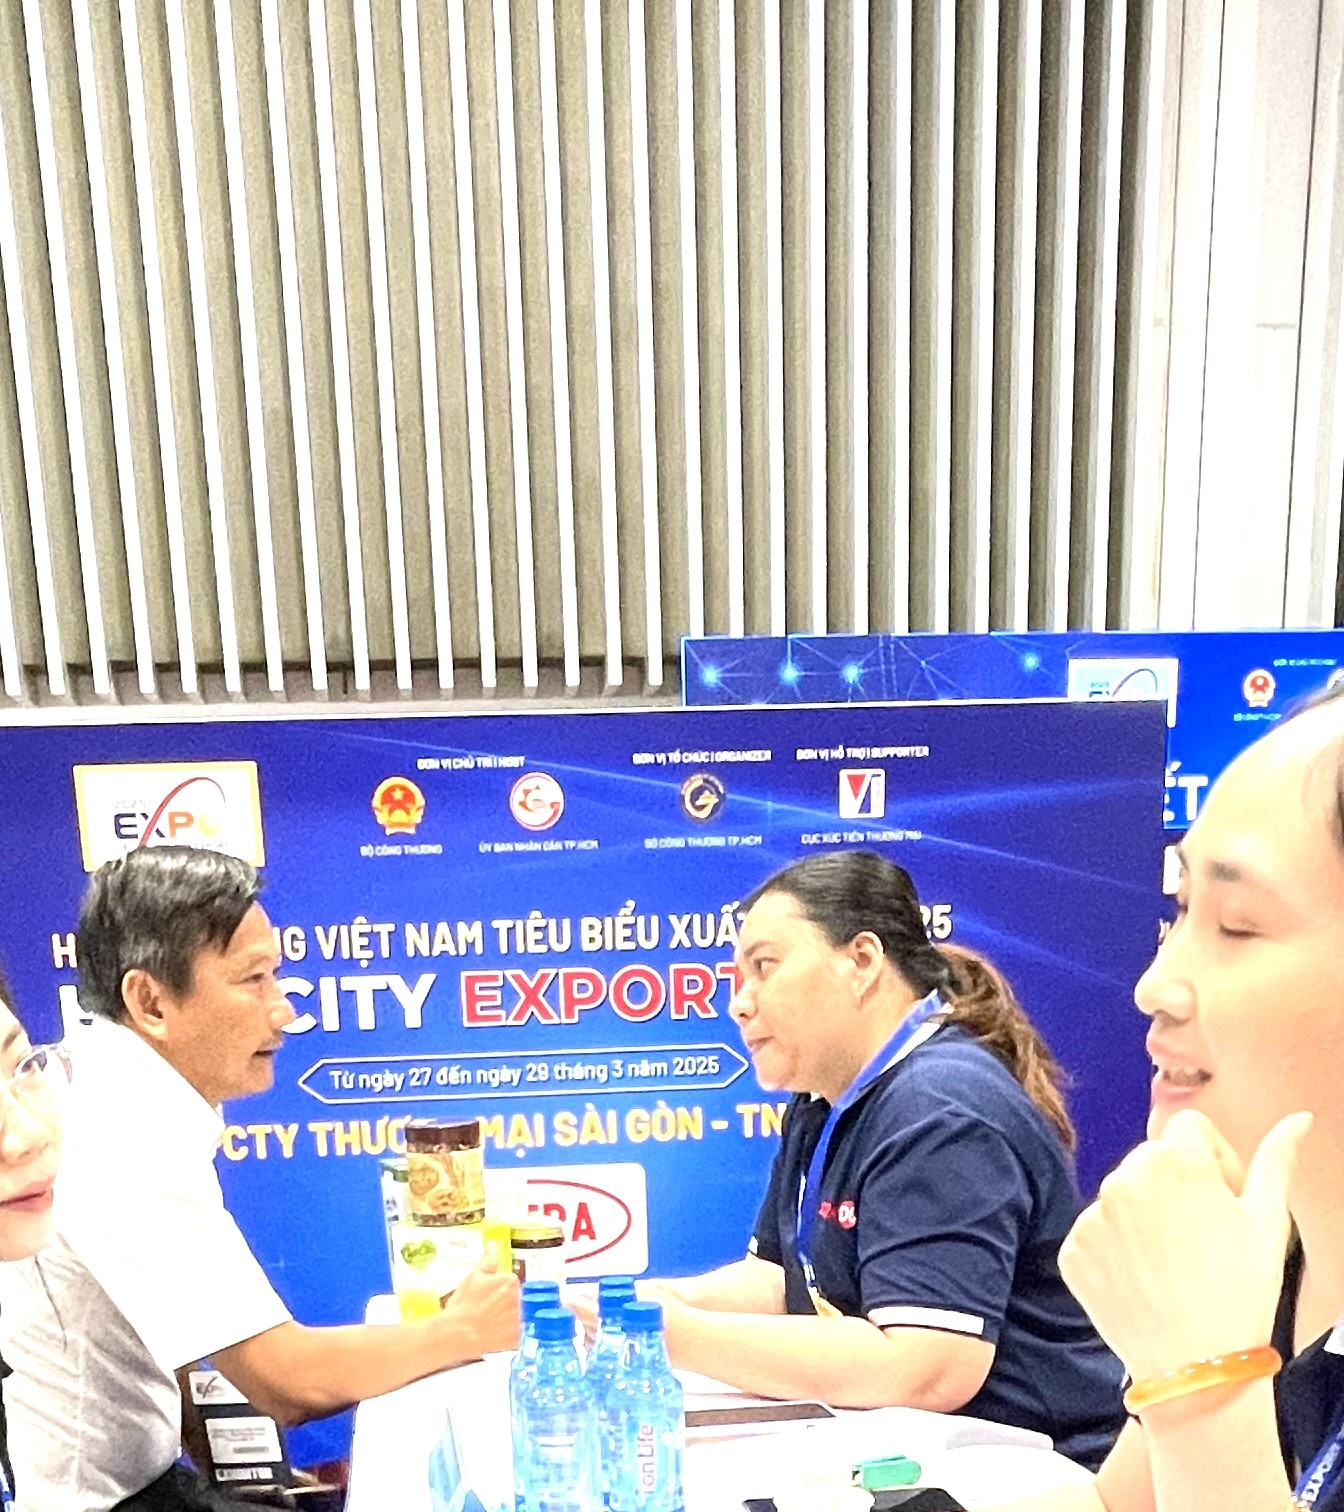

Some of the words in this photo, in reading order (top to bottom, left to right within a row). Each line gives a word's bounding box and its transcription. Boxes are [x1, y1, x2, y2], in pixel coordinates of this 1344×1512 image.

[715, 749, 772, 763] ORGANIZER
[871, 746, 930, 759] SUPPORTER
[315, 916, 395, 968] VIỆT
[406, 918, 483, 957] NAM
[492, 911, 572, 954] TIÊU
[581, 899, 659, 951] BIỂU
[669, 900, 744, 950] XUẤ
[278, 972, 437, 1034] CITY
[329, 1067, 354, 1091] Từ
[359, 1066, 405, 1093] ngày
[408, 1067, 432, 1088] 27
[435, 1063, 472, 1087] đến
[476, 1062, 522, 1089] ngày
[554, 1059, 608, 1085] tháng
[611, 1059, 623, 1079] 3
[627, 1058, 668, 1079] năm
[672, 1056, 721, 1077] 2025
[222, 1122, 303, 1162] CTY
[308, 1114, 409, 1159] THƯƠ
[476, 1110, 545, 1158] MẠI
[554, 1102, 617, 1147] SÀI
[625, 1100, 704, 1142] GÒN
[736, 1103, 788, 1140] TN
